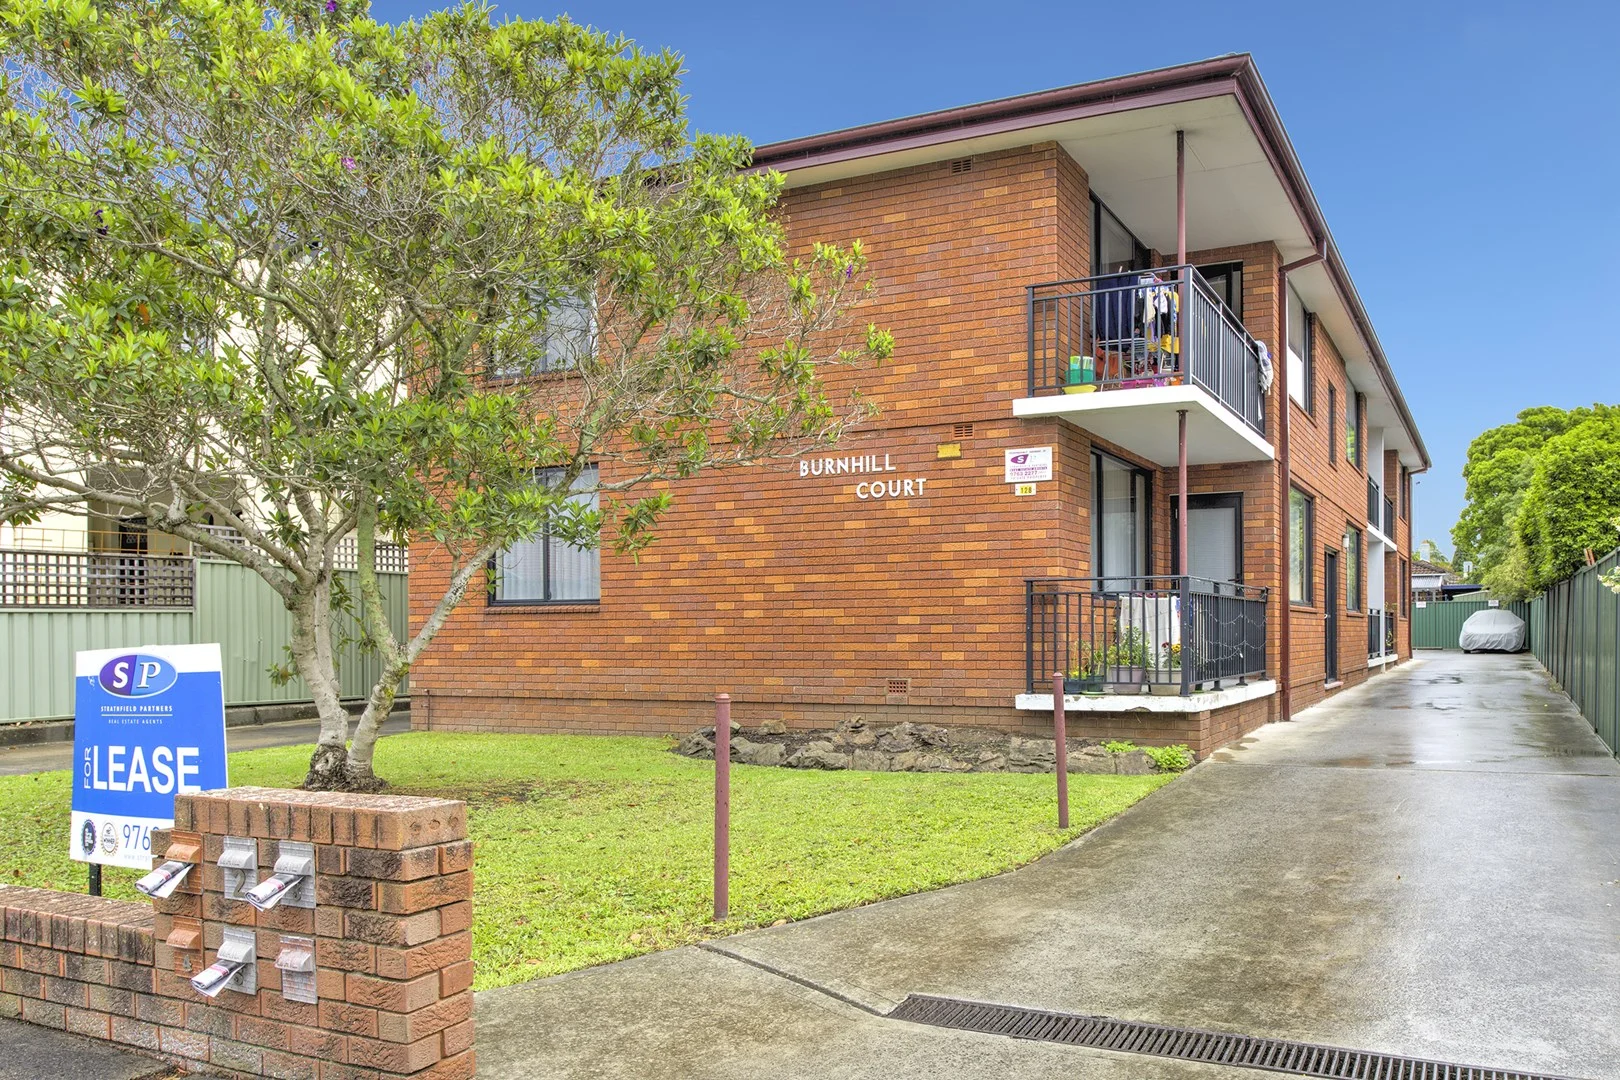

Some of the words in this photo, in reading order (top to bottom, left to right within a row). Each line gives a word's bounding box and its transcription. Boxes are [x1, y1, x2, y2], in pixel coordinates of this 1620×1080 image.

[800, 454, 896, 477] BURNHILL
[856, 478, 927, 499] COURT
[83, 747, 92, 789] FOR
[93, 745, 201, 794] LEASE
[123, 824, 161, 851] 976
[231, 868, 248, 897] 2
